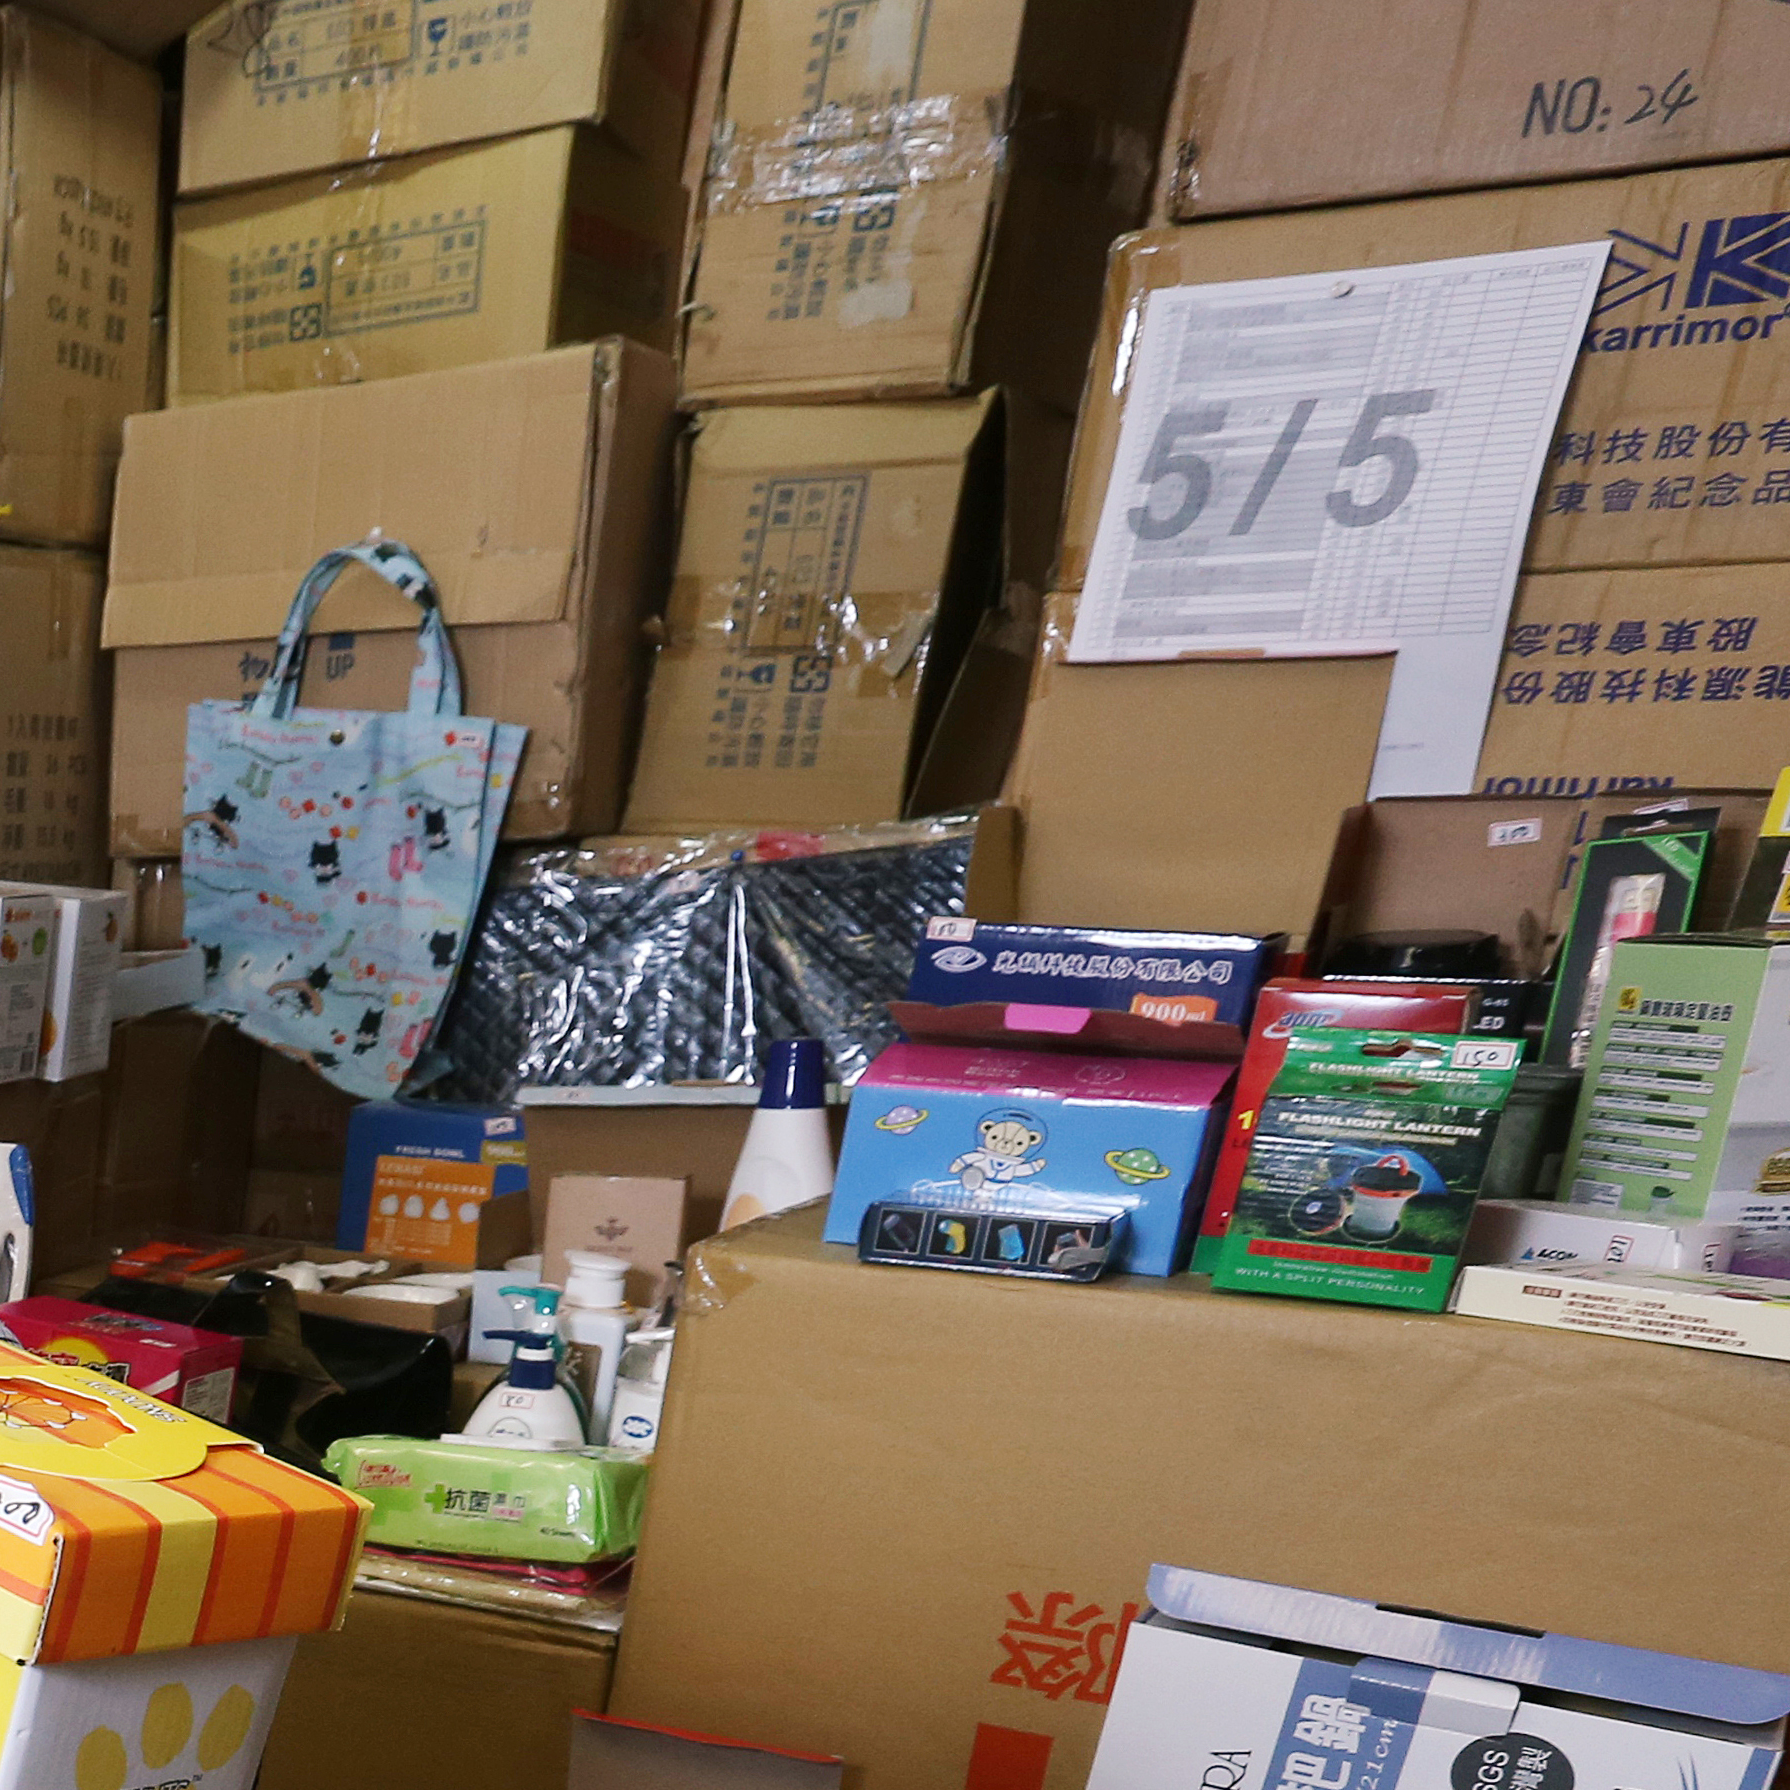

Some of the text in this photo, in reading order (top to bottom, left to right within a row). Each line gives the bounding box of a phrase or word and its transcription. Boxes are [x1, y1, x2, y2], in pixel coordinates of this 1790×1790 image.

[1521, 68, 1699, 138] NO: 24
[1548, 470, 1790, 515] 東會紀念品
[1277, 1112, 1482, 1137] FLASHLIGHT LANTERN
[1235, 1267, 1268, 1277] WITH
